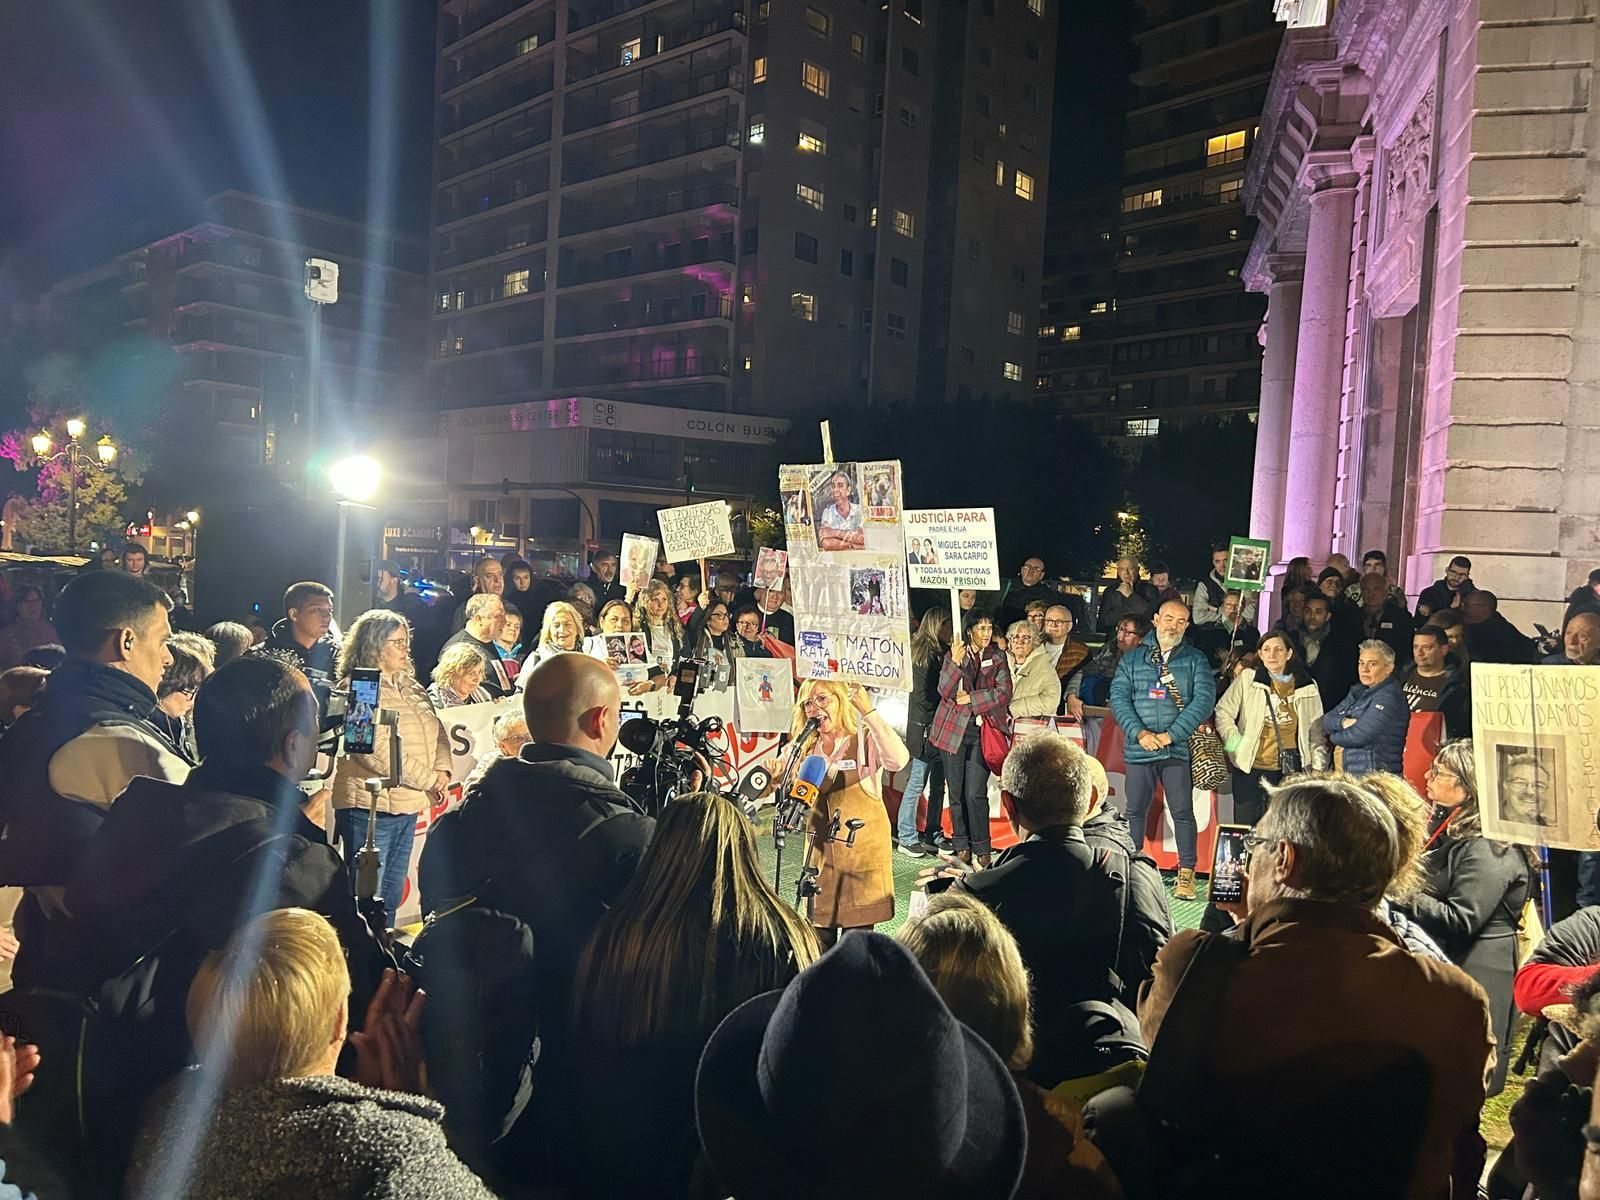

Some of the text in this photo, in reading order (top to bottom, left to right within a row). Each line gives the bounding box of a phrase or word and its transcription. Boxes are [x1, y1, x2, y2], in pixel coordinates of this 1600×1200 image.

[674, 503, 721, 520] IZQUIERDAS
[957, 511, 987, 522] PARA
[676, 515, 715, 531] DERECHAS
[665, 525, 720, 543] QUEREMOS UN
[668, 537, 707, 552] GOBIERNO
[937, 540, 993, 549] MIGUEL CARPIO Y
[944, 551, 988, 560] SARA CARPIO
[943, 567, 957, 575] LAS
[920, 575, 948, 584] MAZÓN
[800, 645, 831, 658] RATA
[846, 634, 904, 657] MATÓN
[861, 651, 876, 661] AL
[1475, 674, 1494, 698] NI
[1475, 701, 1594, 729] NI OLVDAMOS
